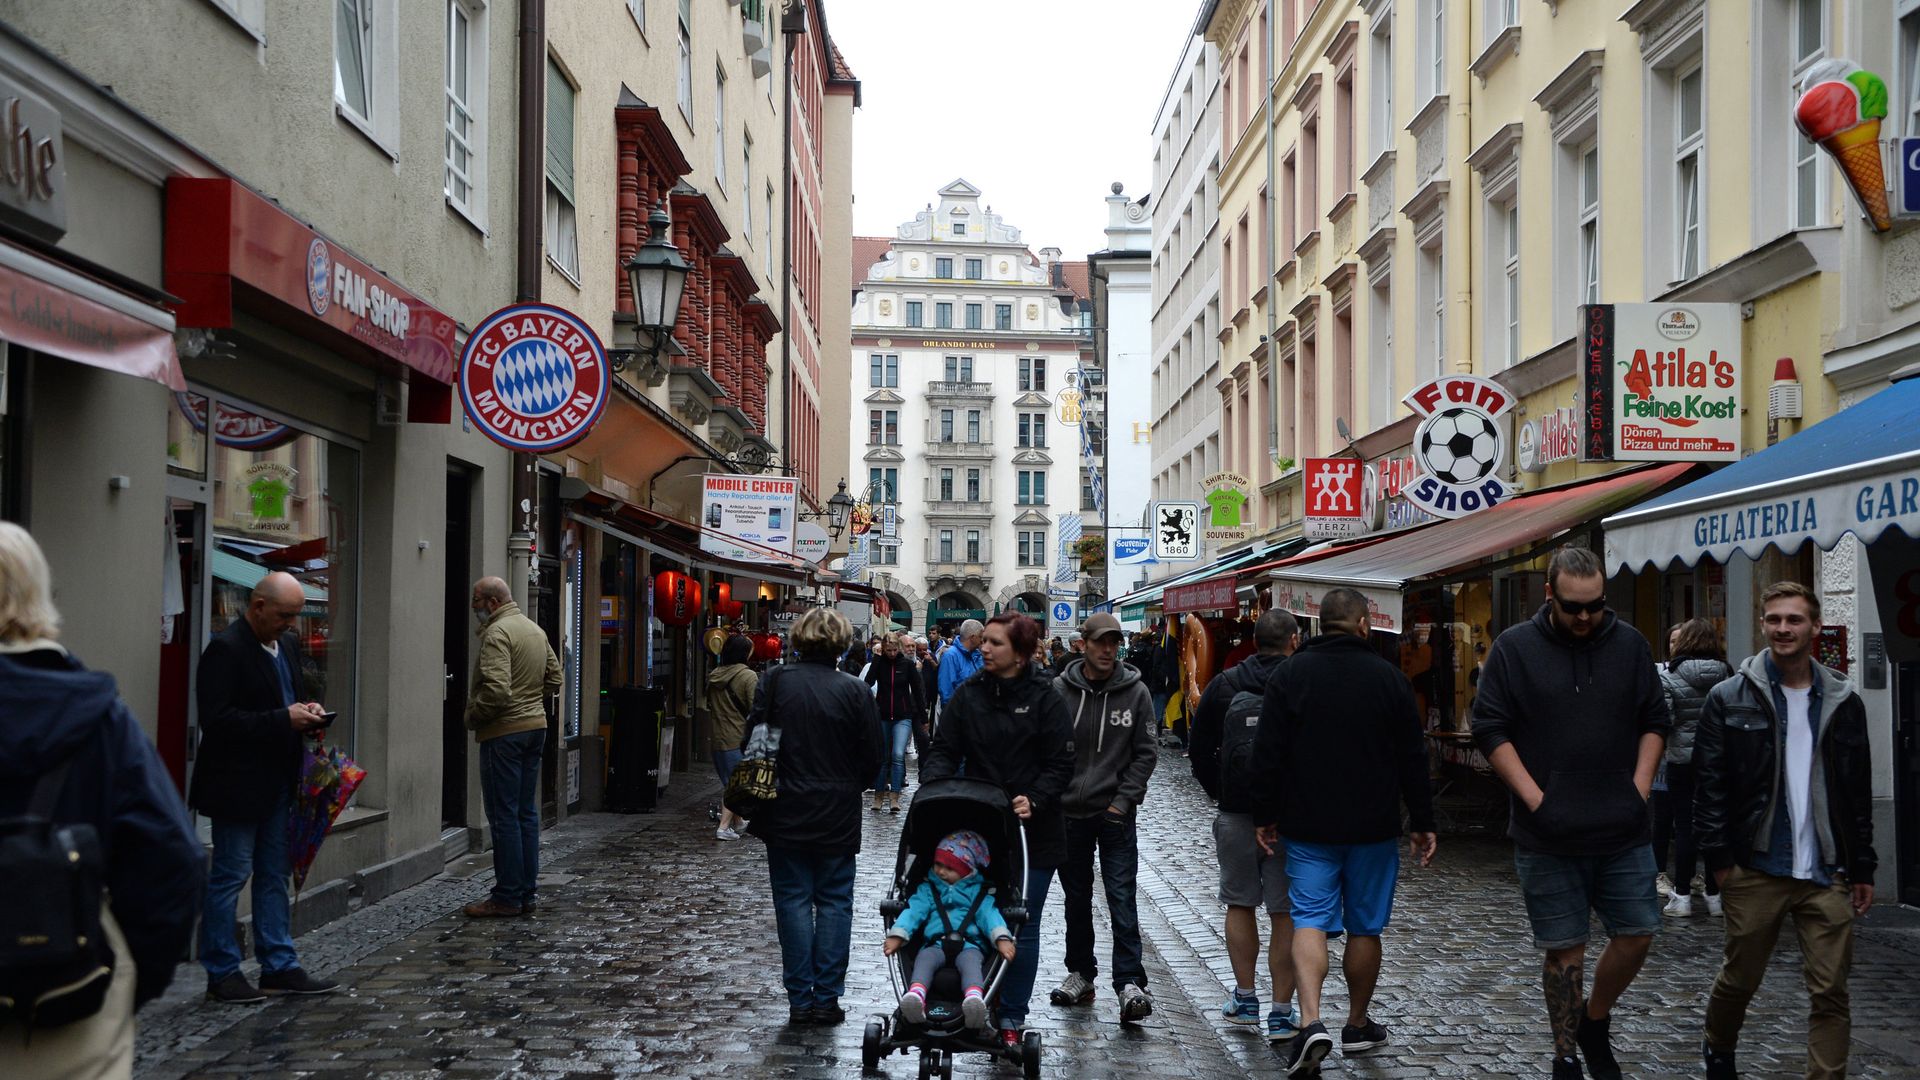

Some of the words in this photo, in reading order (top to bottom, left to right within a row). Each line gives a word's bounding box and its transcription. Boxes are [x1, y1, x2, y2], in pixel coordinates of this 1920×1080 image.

[3, 97, 55, 200] he
[333, 261, 410, 341] FAN-SHOP
[473, 337, 500, 369] FC
[500, 317, 595, 370] BAYERN
[1626, 347, 1735, 389] Atila's
[1413, 380, 1506, 416] Fan
[1623, 393, 1682, 419] Feine
[1684, 393, 1737, 419] Kost
[475, 389, 594, 440] MÜNCHEN
[1624, 425, 1661, 439] Döner,
[1624, 439, 1653, 451] Pizza
[1657, 439, 1679, 451] und
[1683, 441, 1713, 451] mehr
[706, 478, 748, 492] MOBILE
[751, 481, 794, 494] CENTER
[1205, 474, 1247, 486] SHIRT-SHOP
[707, 491, 730, 500] Handy
[731, 492, 765, 501] Reparatur
[1317, 523, 1350, 531] TERZI
[1694, 497, 1818, 547] GELATERIA
[1206, 531, 1245, 539] SOUVENIRS
[1116, 540, 1148, 548] Souvenirs
[1165, 546, 1188, 554] 1860
[1110, 709, 1133, 728] 58
